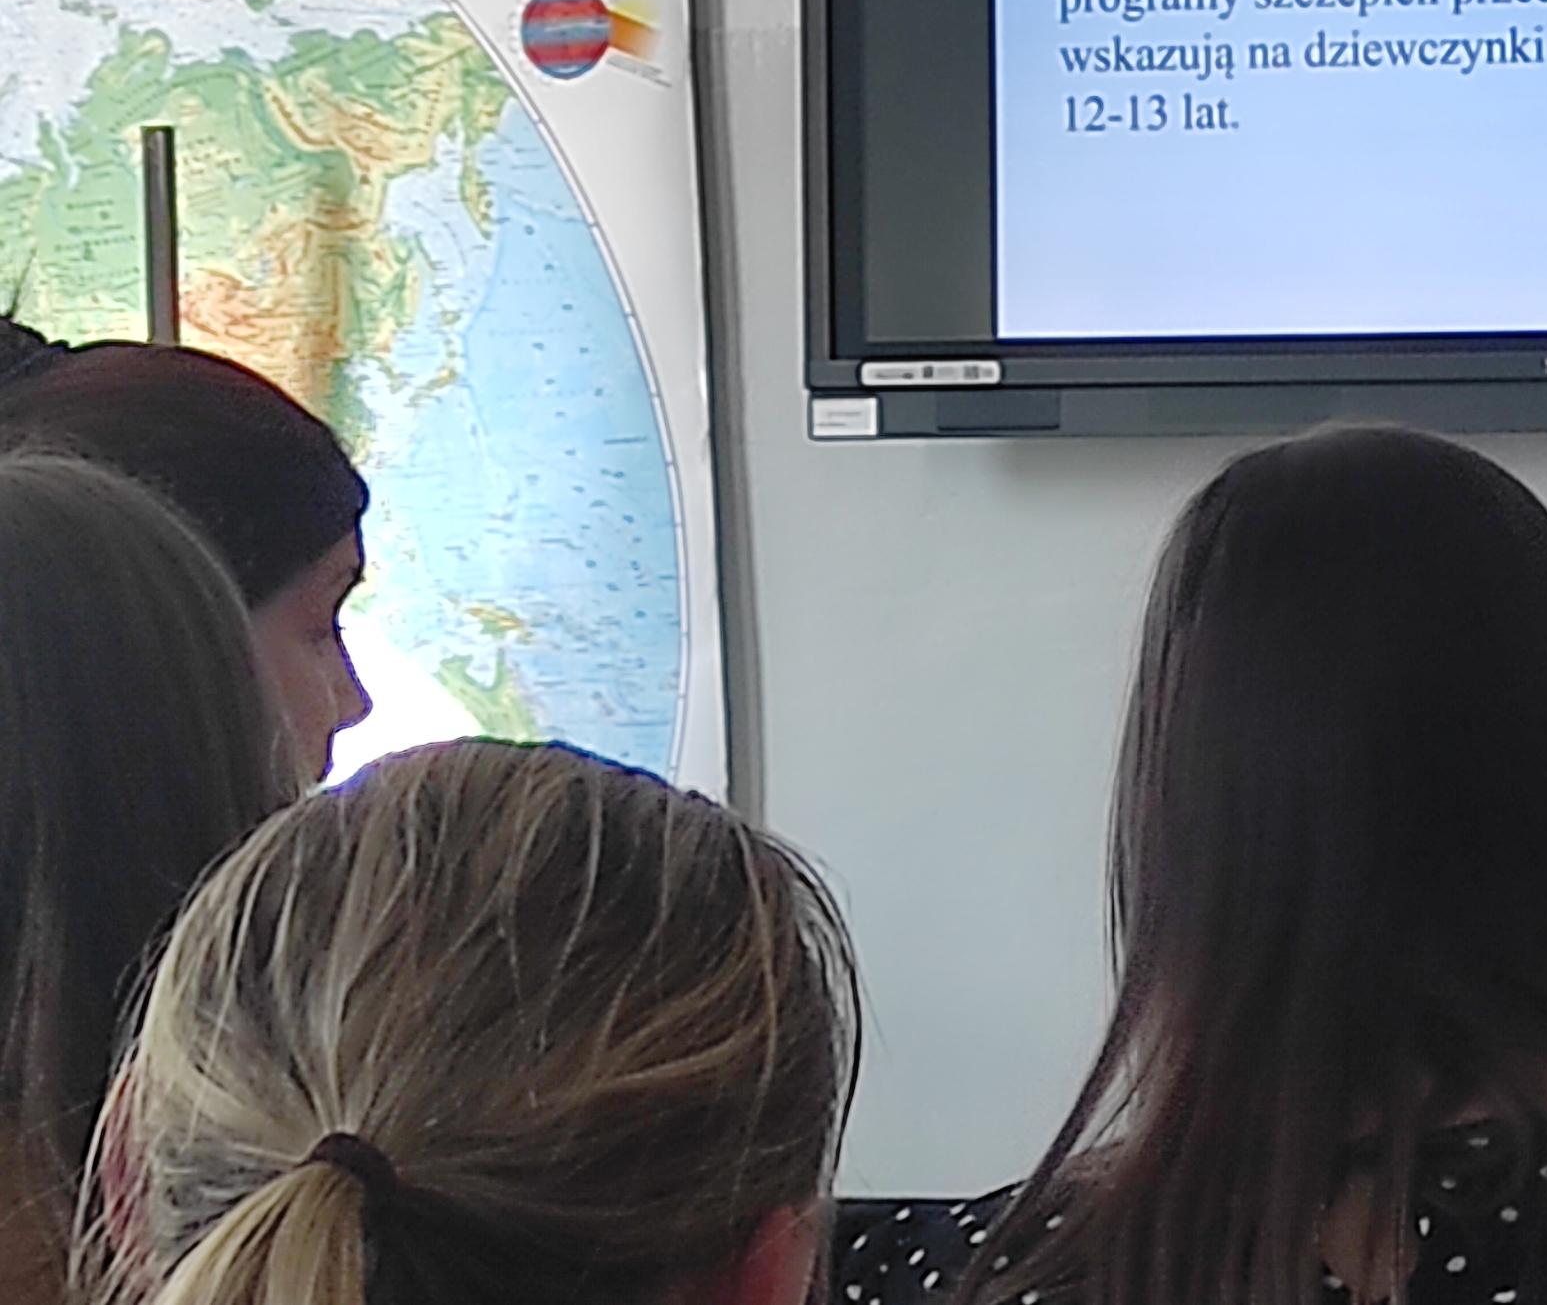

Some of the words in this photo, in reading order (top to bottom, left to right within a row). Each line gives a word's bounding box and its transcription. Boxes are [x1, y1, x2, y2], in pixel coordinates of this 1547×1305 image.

[1058, 31, 1236, 82] wskazują
[1247, 41, 1293, 71] na
[1303, 23, 1546, 77] dziewczynki
[1065, 93, 1169, 134] 12-13
[1182, 91, 1240, 131] lat.
